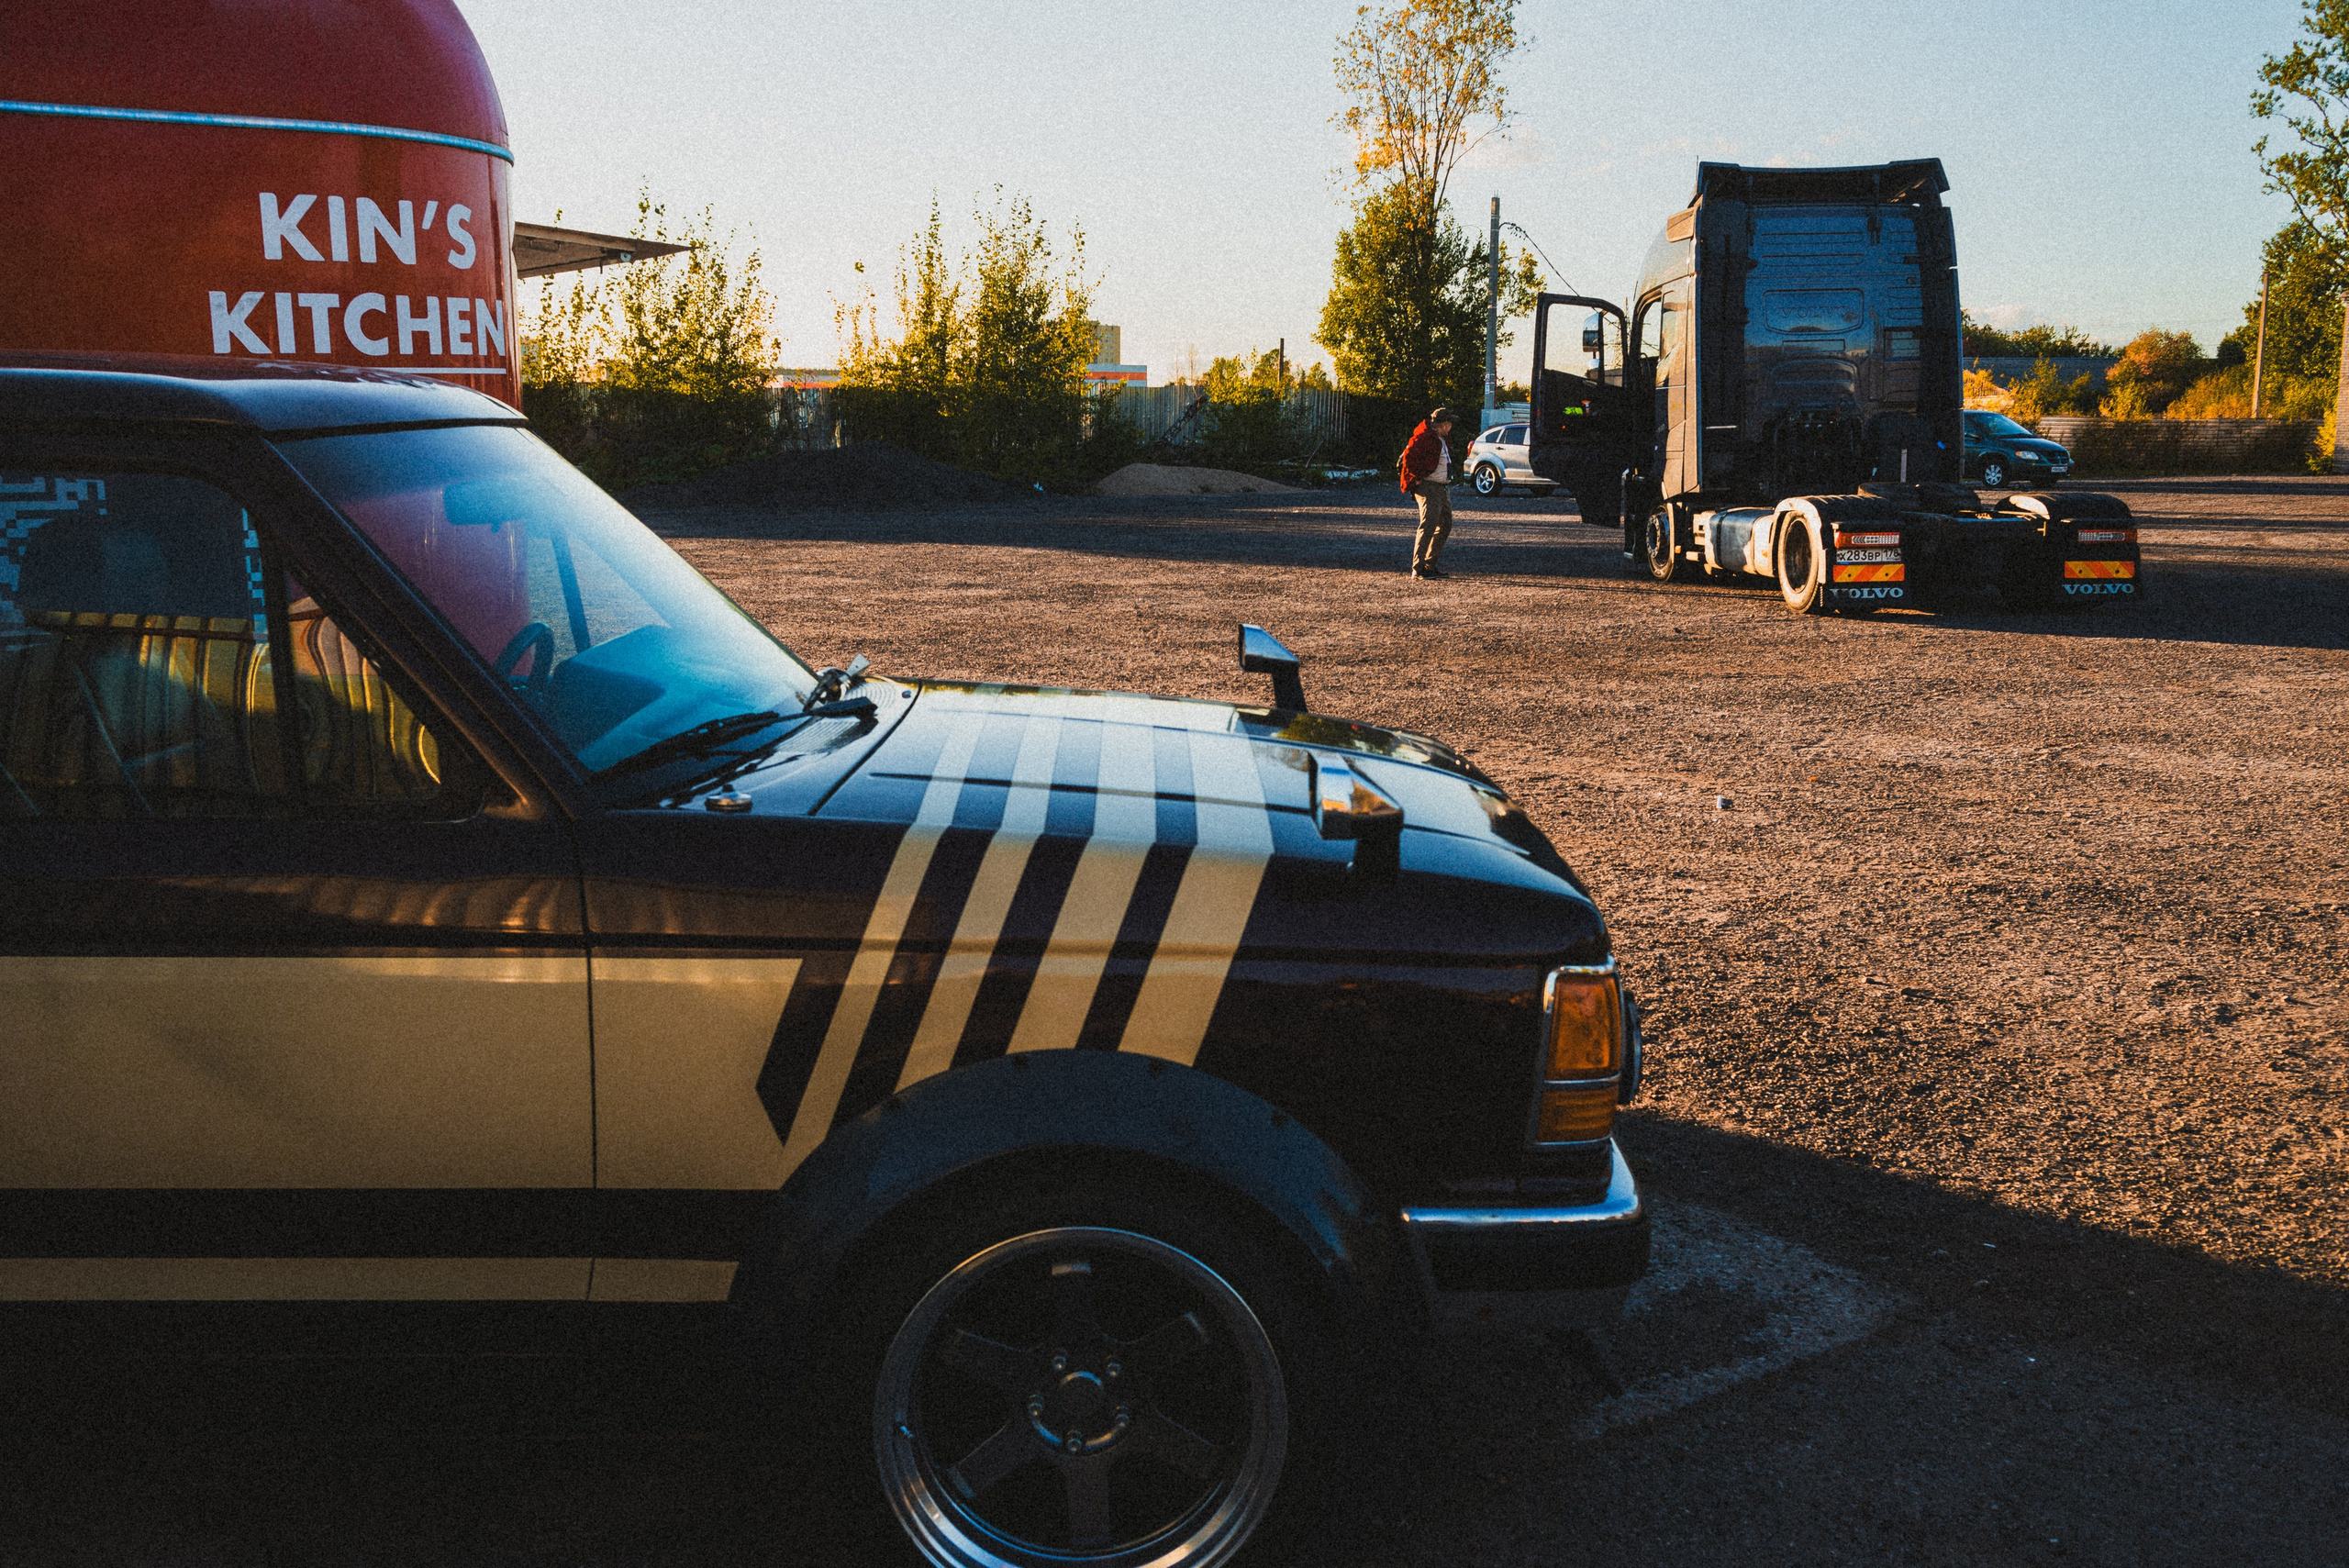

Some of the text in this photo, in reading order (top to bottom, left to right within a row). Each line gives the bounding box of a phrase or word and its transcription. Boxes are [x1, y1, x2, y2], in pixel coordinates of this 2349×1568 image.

[259, 193, 477, 270] KIN'S
[208, 290, 506, 357] KITCHEN
[2062, 584, 2134, 595] VOLVO
